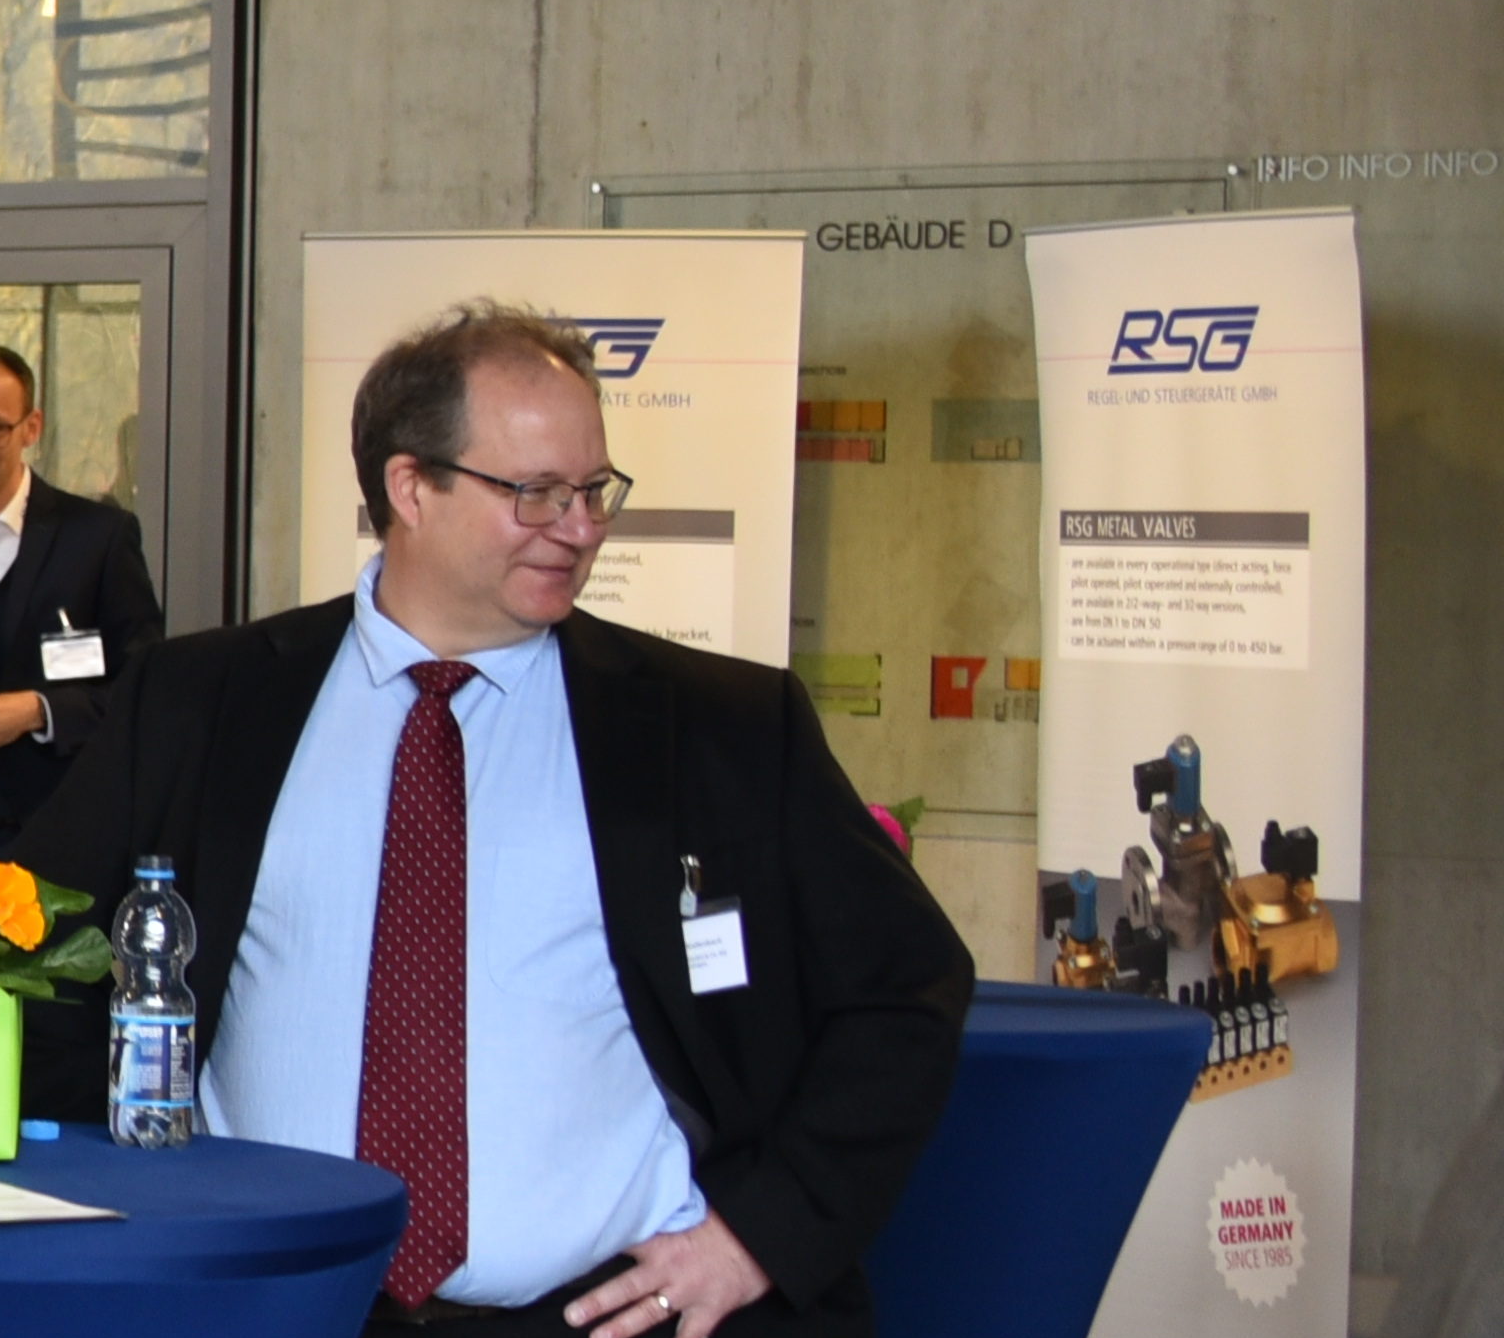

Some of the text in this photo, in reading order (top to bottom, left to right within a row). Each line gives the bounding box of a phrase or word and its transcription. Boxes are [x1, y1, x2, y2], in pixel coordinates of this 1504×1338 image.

[1257, 149, 1498, 183] INFO INFO INFO
[816, 215, 1013, 251] GEBÄUDE D
[1107, 305, 1260, 375] RSG
[637, 393, 691, 408] GMBH
[1241, 386, 1278, 402] GMBH
[1065, 515, 1196, 539] RSG METAL VALVES
[595, 554, 643, 566] ntrolled,
[1220, 1196, 1287, 1220] MADE IN
[1218, 1220, 1294, 1246] GERMANY
[1224, 1247, 1293, 1271] SINCE 1985
